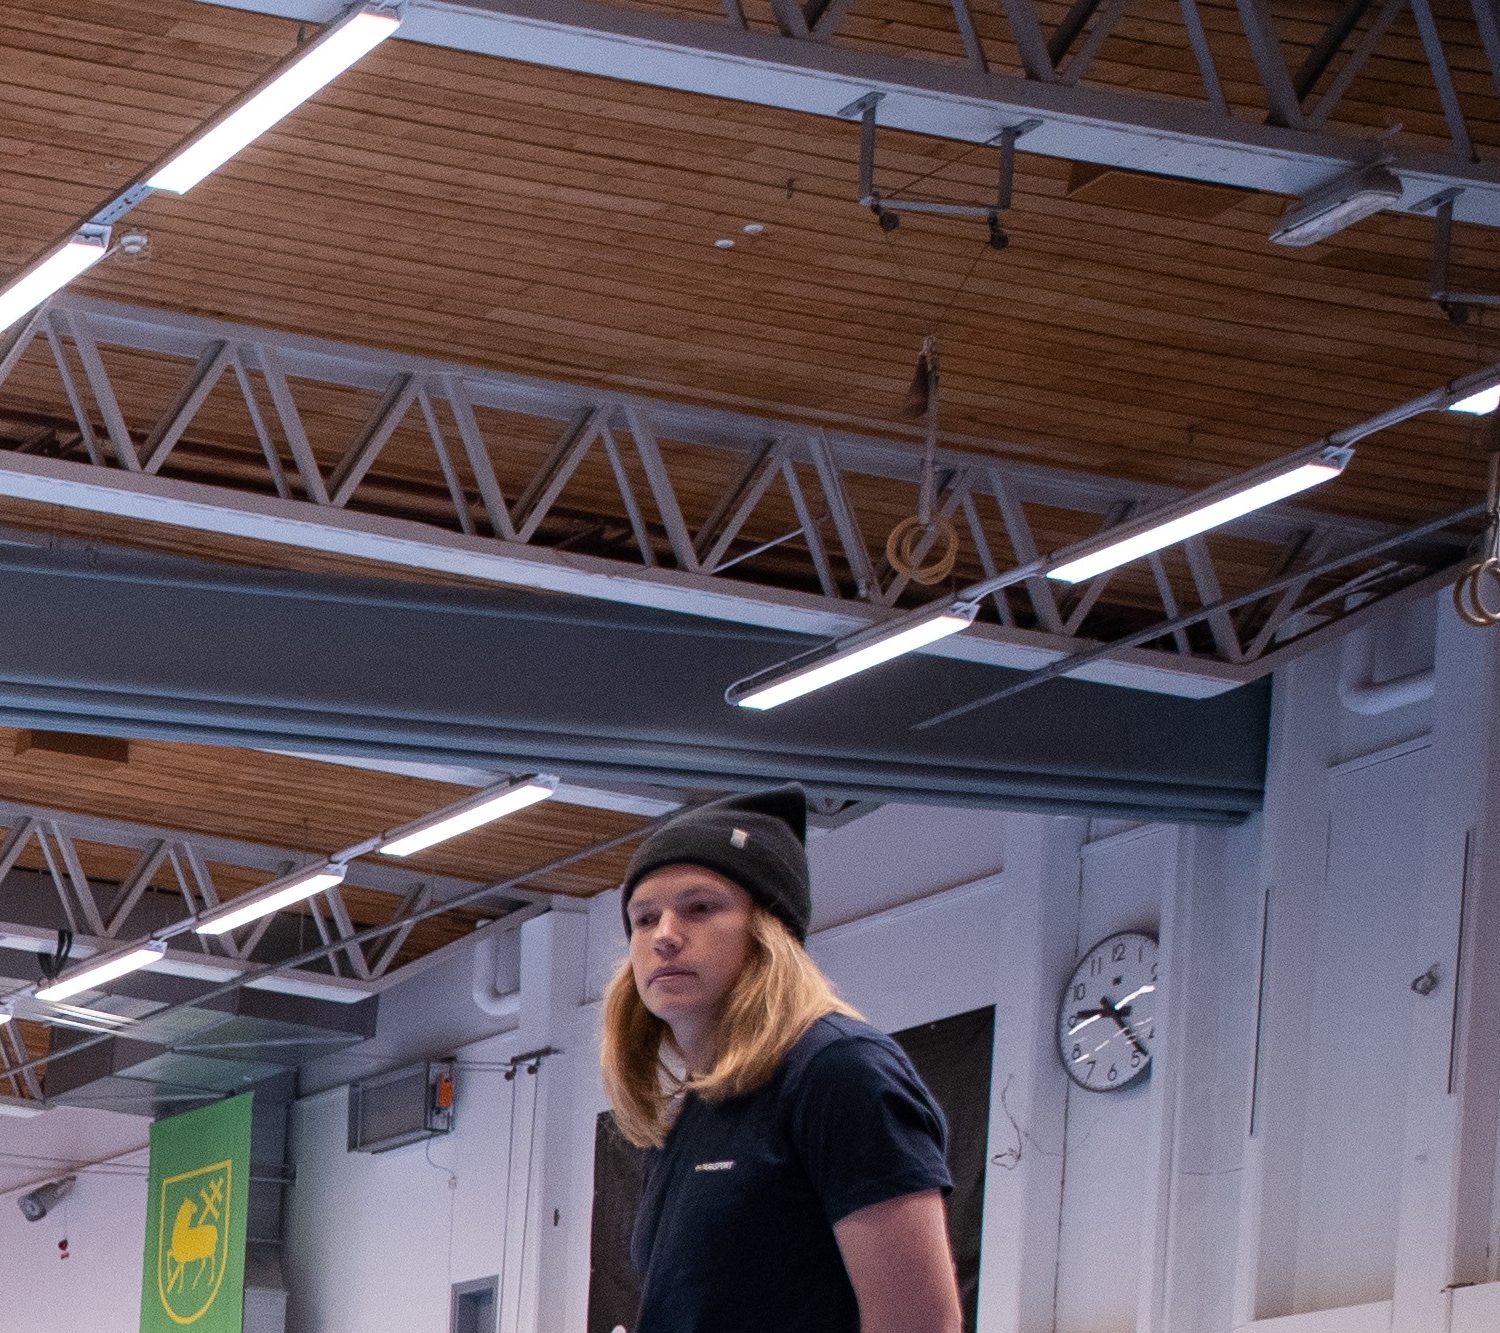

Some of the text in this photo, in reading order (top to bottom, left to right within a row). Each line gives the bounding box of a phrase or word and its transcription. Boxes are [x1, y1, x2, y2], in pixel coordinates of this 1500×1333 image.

[1112, 943, 1126, 963] 12
[1090, 956, 1102, 977] 11
[1072, 982, 1086, 1003] 10
